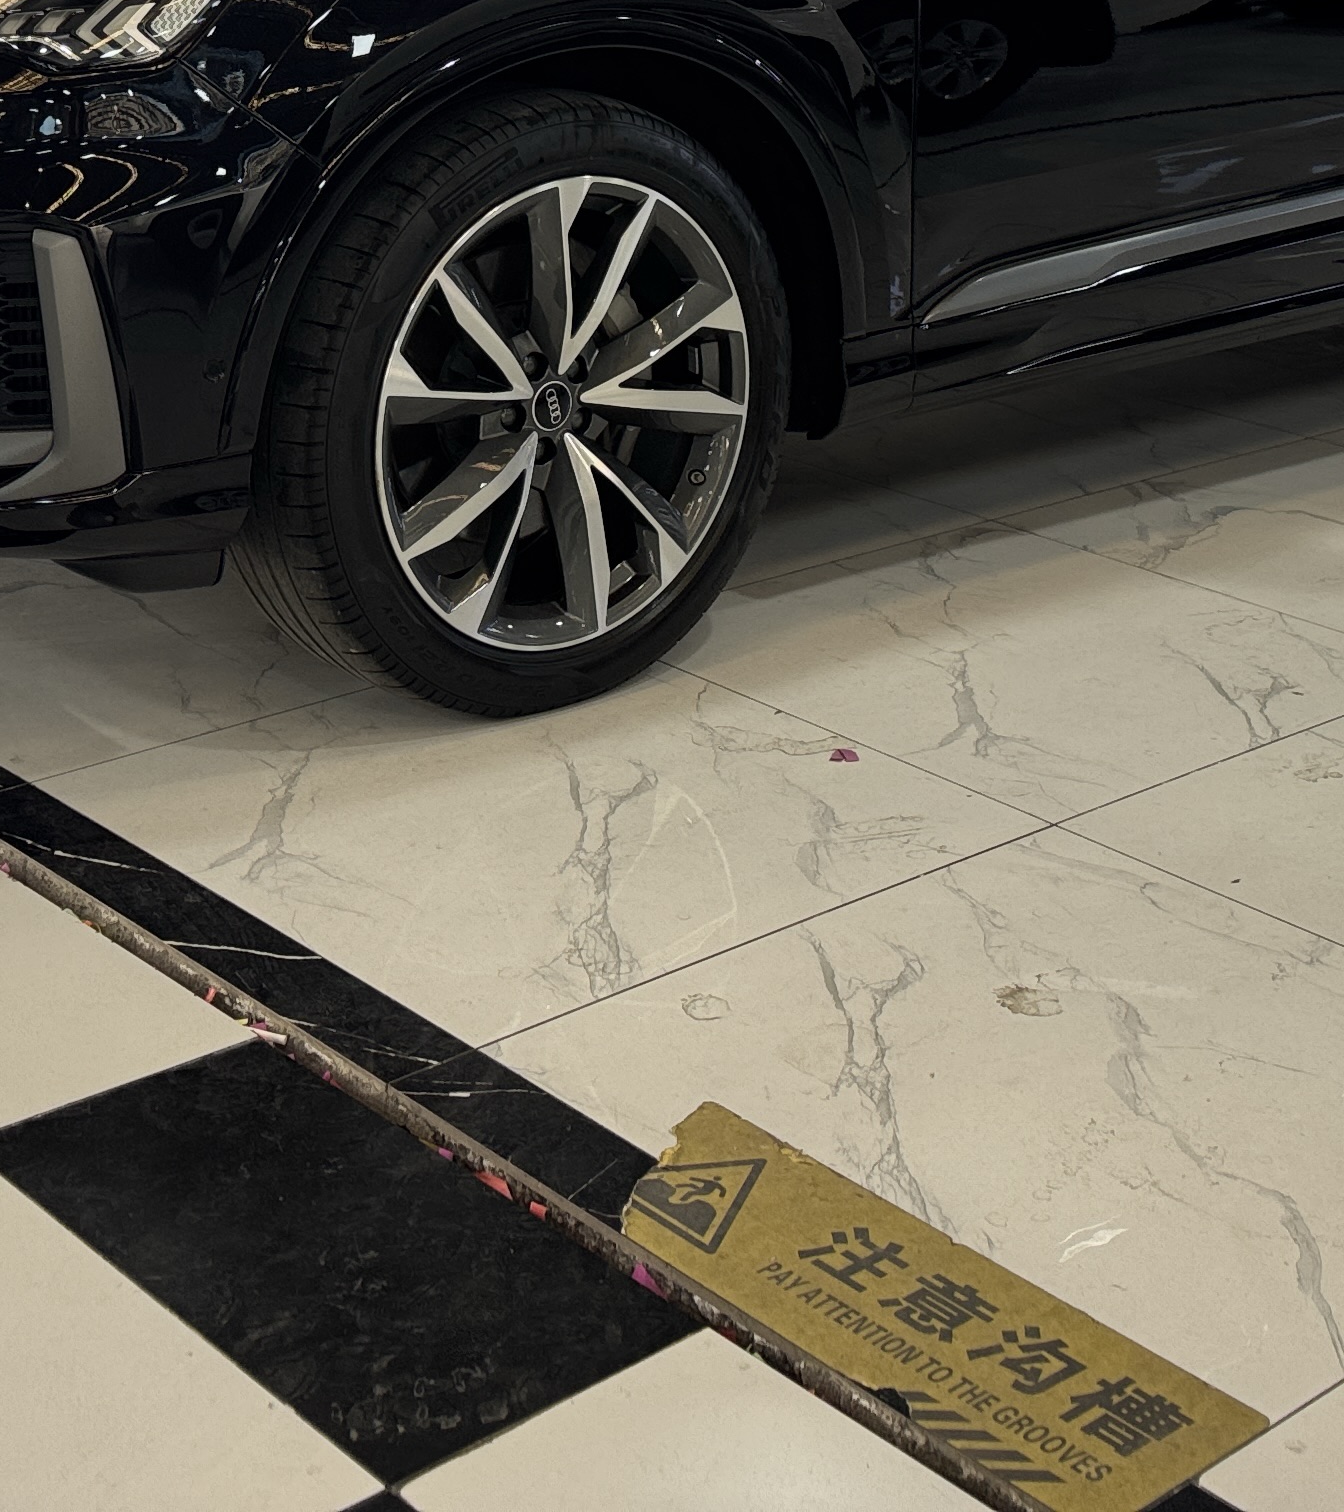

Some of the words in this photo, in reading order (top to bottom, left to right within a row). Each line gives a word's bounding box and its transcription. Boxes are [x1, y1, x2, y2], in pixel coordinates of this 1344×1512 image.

[756, 1260, 811, 1290] PAY
[799, 1287, 924, 1366] ATTENTION
[917, 1356, 954, 1384] TO
[950, 1376, 1001, 1412] THE
[991, 1405, 1113, 1482] GROOVES
[797, 1226, 1195, 1457] 注意沟槽
